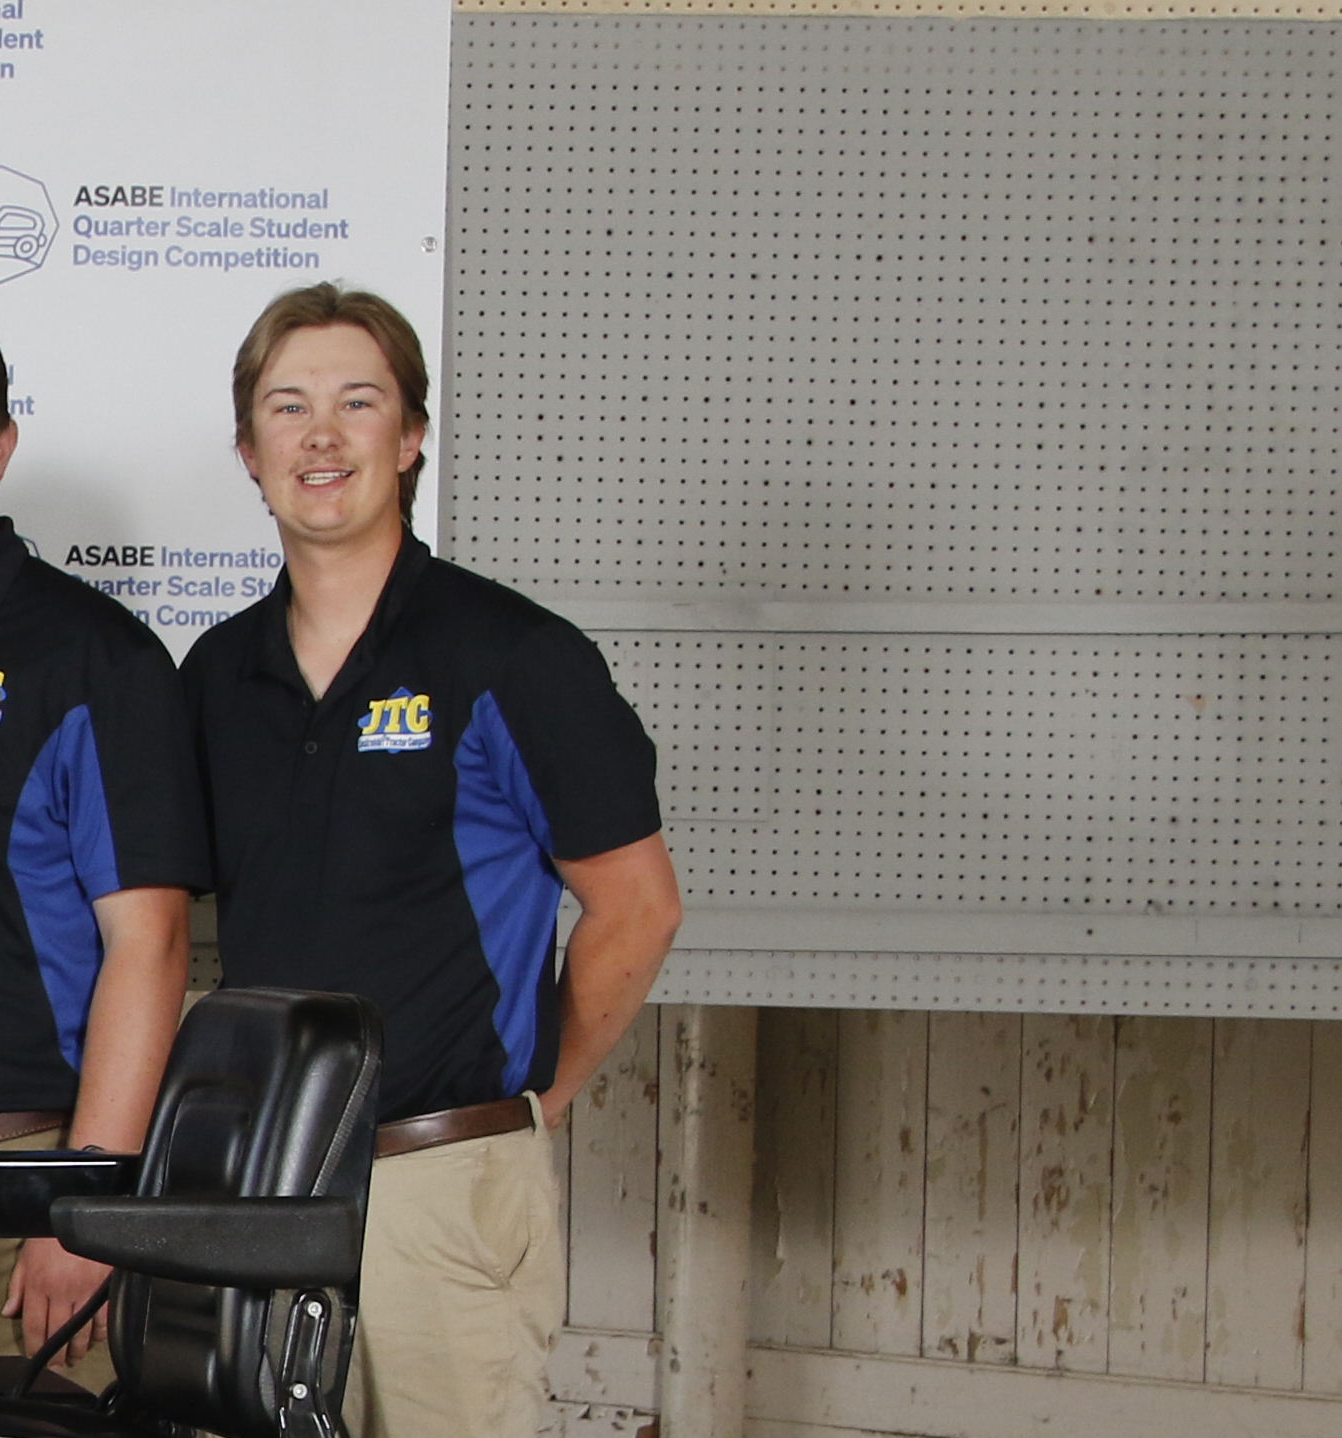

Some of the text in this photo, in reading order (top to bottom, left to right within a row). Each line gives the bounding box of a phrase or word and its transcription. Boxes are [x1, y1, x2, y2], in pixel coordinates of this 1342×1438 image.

[72, 185, 328, 210] ASABE International
[72, 215, 348, 239] Quarter Scale Student
[73, 245, 319, 272] Design Competition
[66, 545, 282, 569] ASABE Internatio
[167, 576, 235, 598] Scale
[362, 694, 429, 734] JTC
